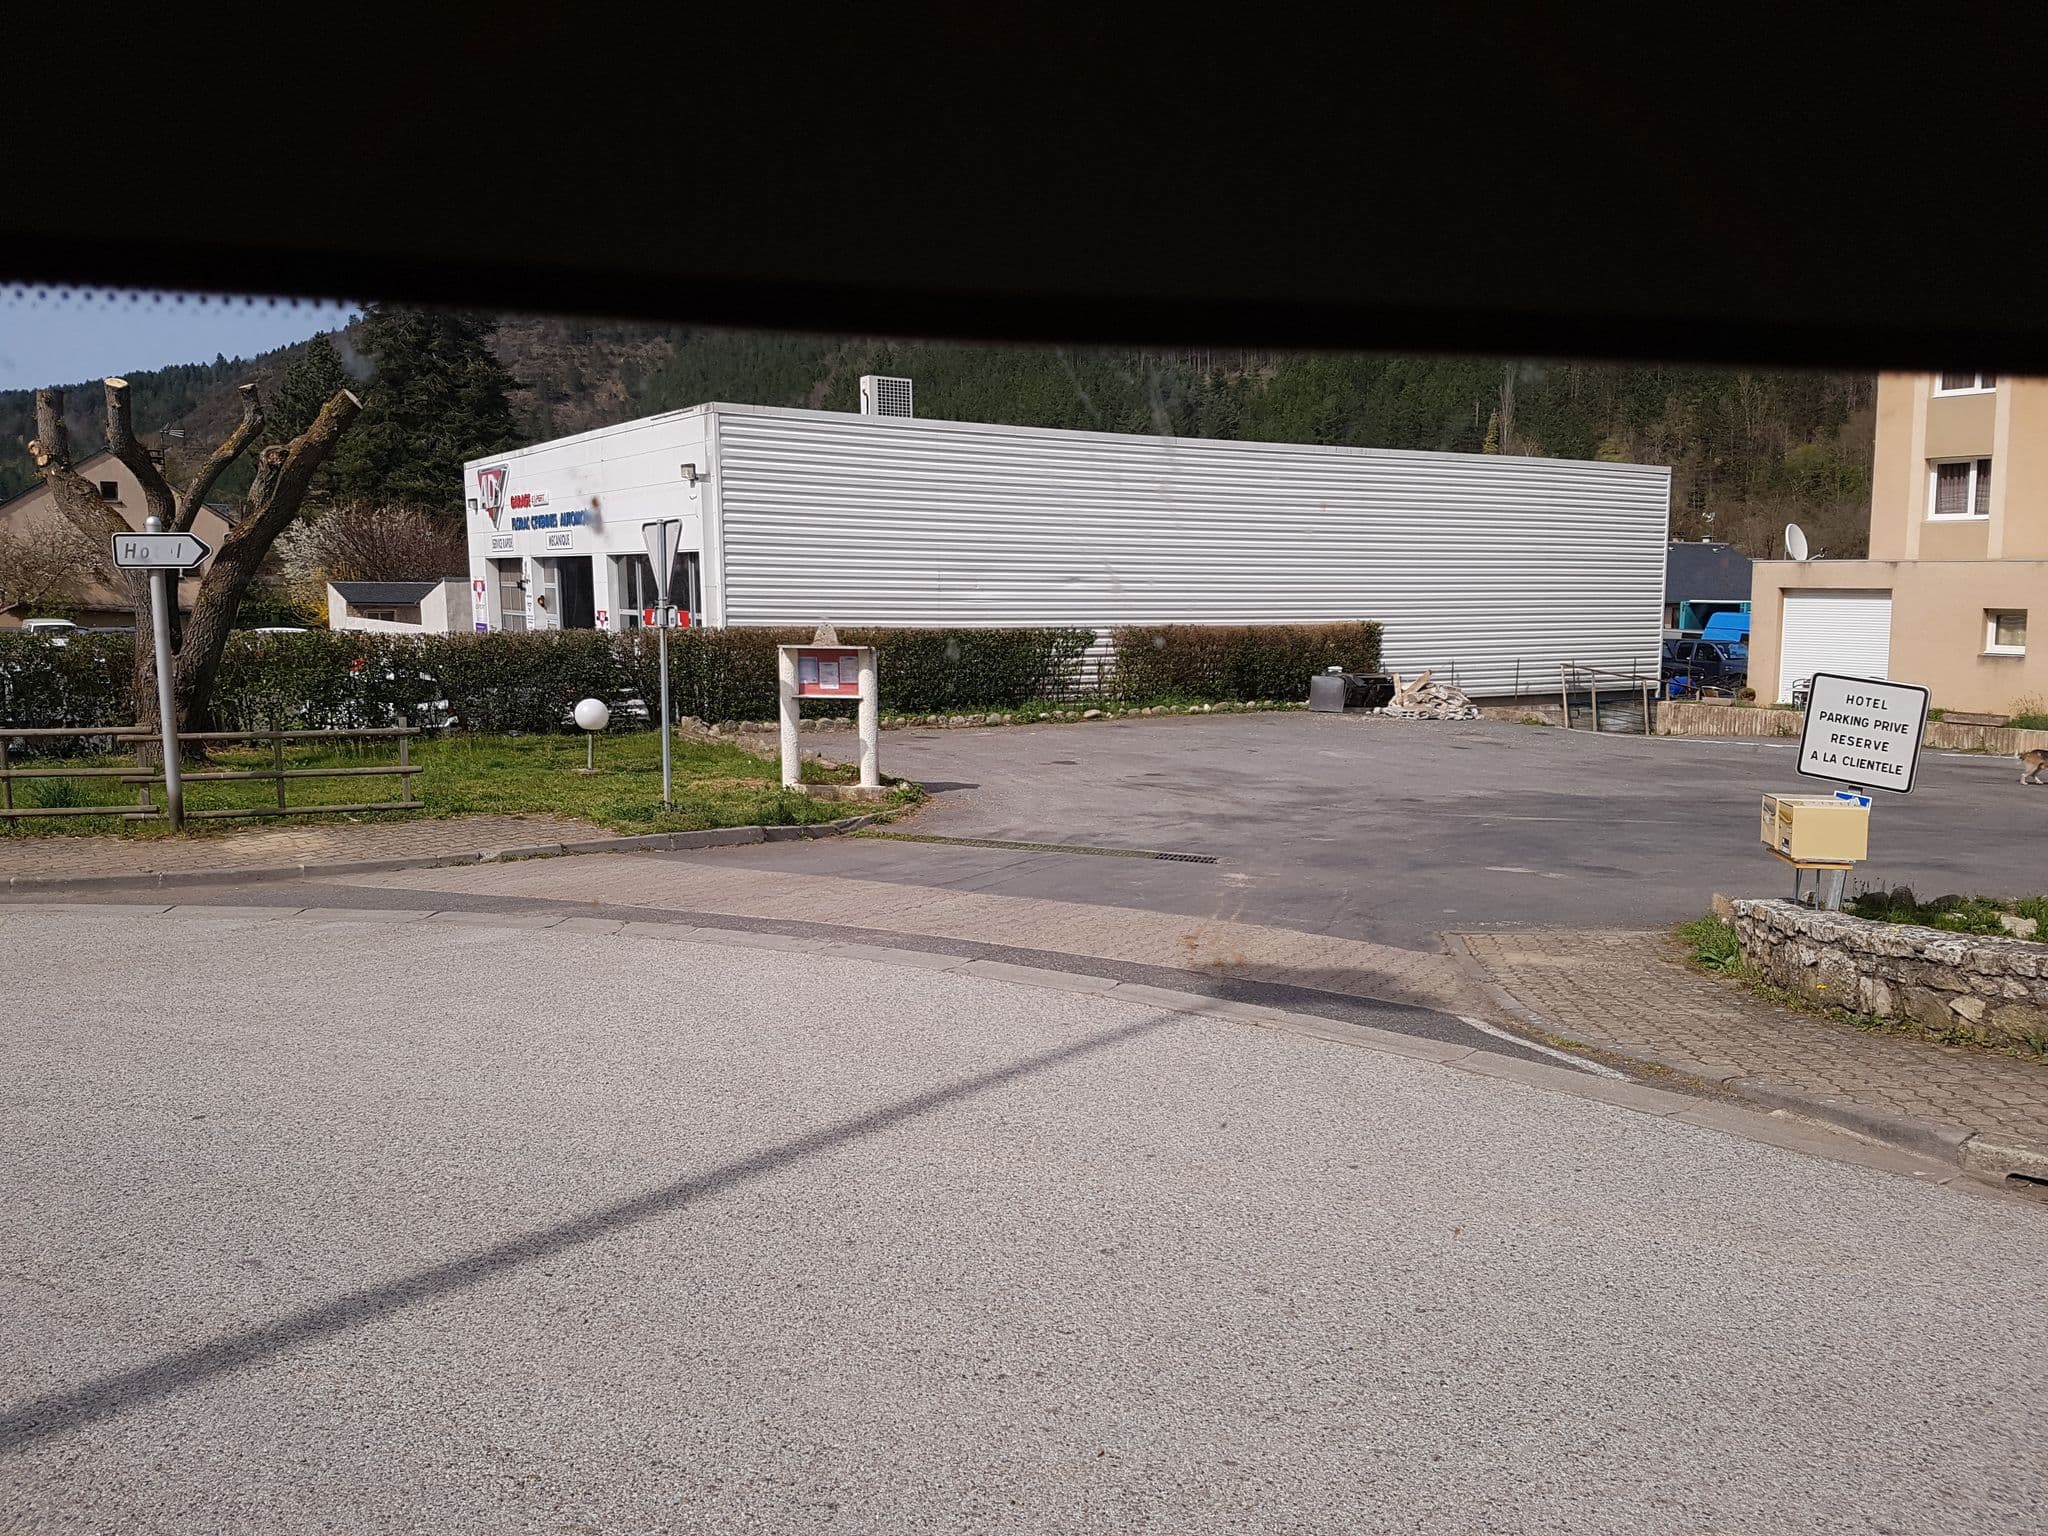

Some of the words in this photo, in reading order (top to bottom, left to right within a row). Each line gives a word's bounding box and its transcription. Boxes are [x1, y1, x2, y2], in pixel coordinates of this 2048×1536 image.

[510, 493, 531, 509] GARAGE
[548, 533, 570, 547] MECANIQUE
[124, 542, 182, 559] Hol
[1846, 694, 1888, 710] HOTEL
[1819, 710, 1869, 728] PARKING
[1873, 719, 1909, 735] PRIVE
[1830, 733, 1890, 752] RESERVE
[1810, 750, 1818, 761] A
[1823, 752, 1837, 764] LA
[1842, 756, 1904, 776] CLIENTELE
